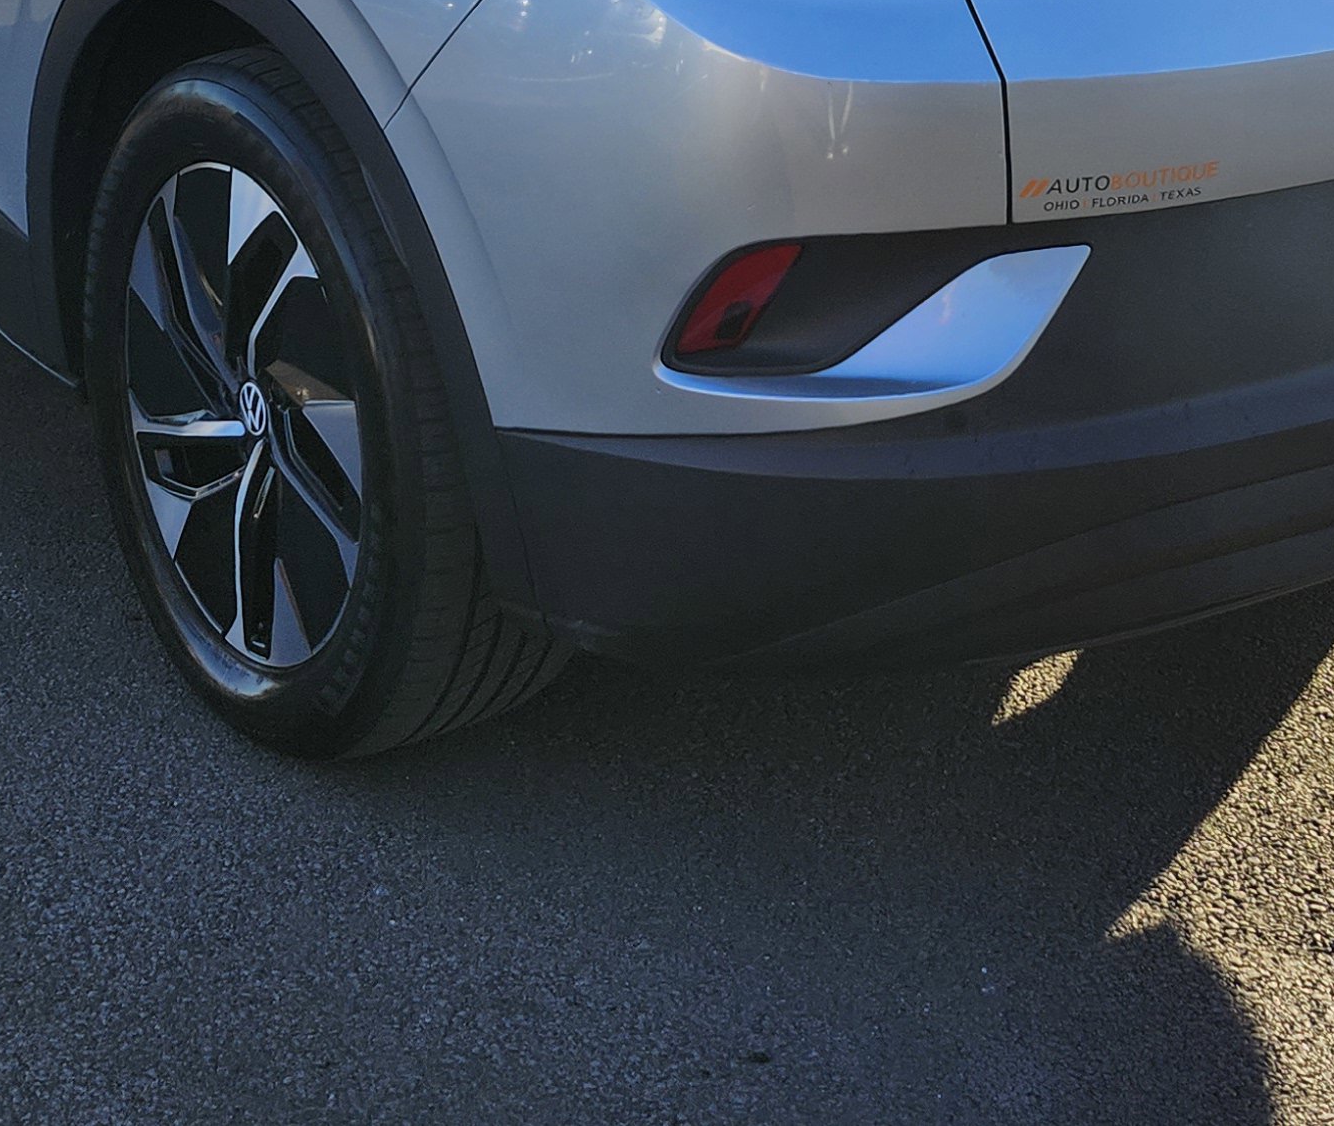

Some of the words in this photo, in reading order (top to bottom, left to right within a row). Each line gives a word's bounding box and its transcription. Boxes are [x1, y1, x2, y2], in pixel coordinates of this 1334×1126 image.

[1043, 199, 1080, 212] OHIO
[1092, 194, 1149, 208] FLORIDA
[1160, 186, 1202, 202] TEXAS
